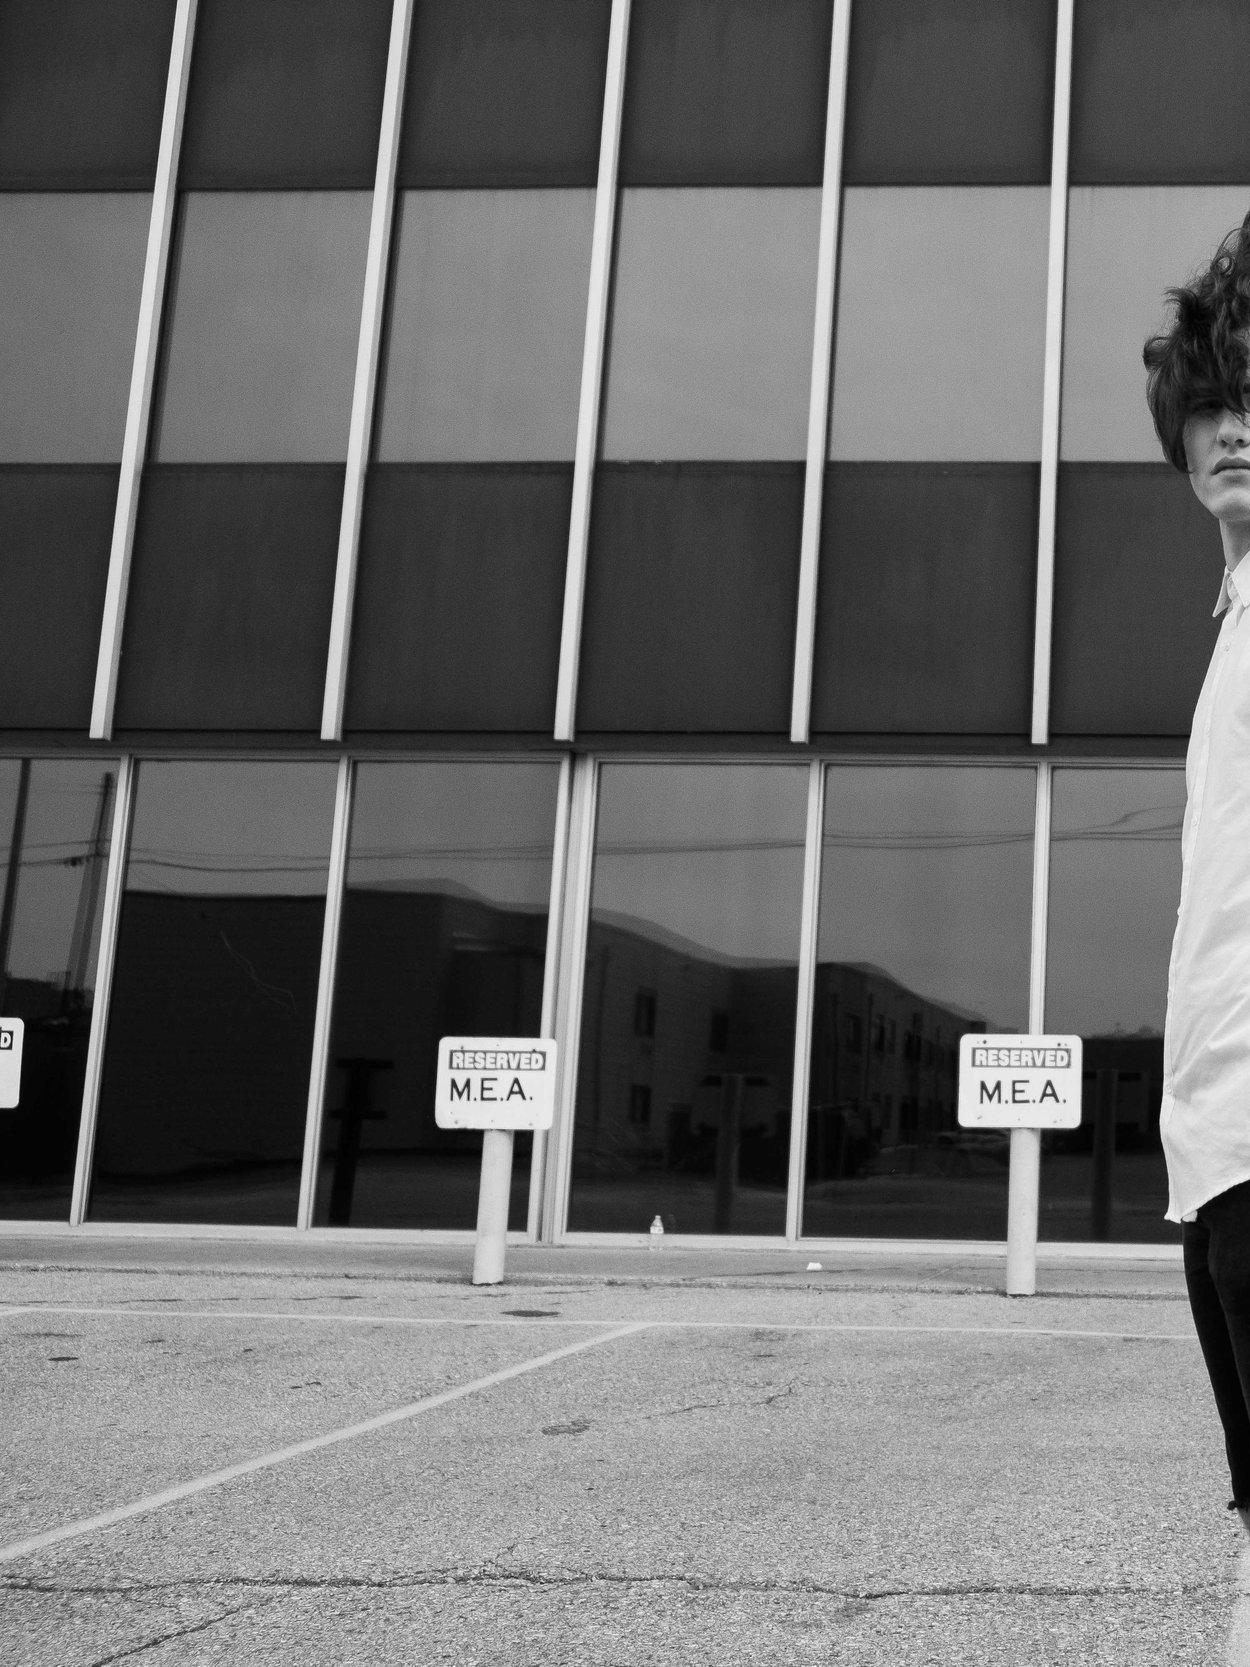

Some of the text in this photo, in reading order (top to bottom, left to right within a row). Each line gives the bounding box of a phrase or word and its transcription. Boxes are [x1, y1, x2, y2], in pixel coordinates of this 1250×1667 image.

[451, 1051, 545, 1070] RESERVED
[974, 1048, 1069, 1068] RESERVED
[450, 1077, 534, 1102] M.E.A.
[979, 1079, 1067, 1104] M.E.A.
